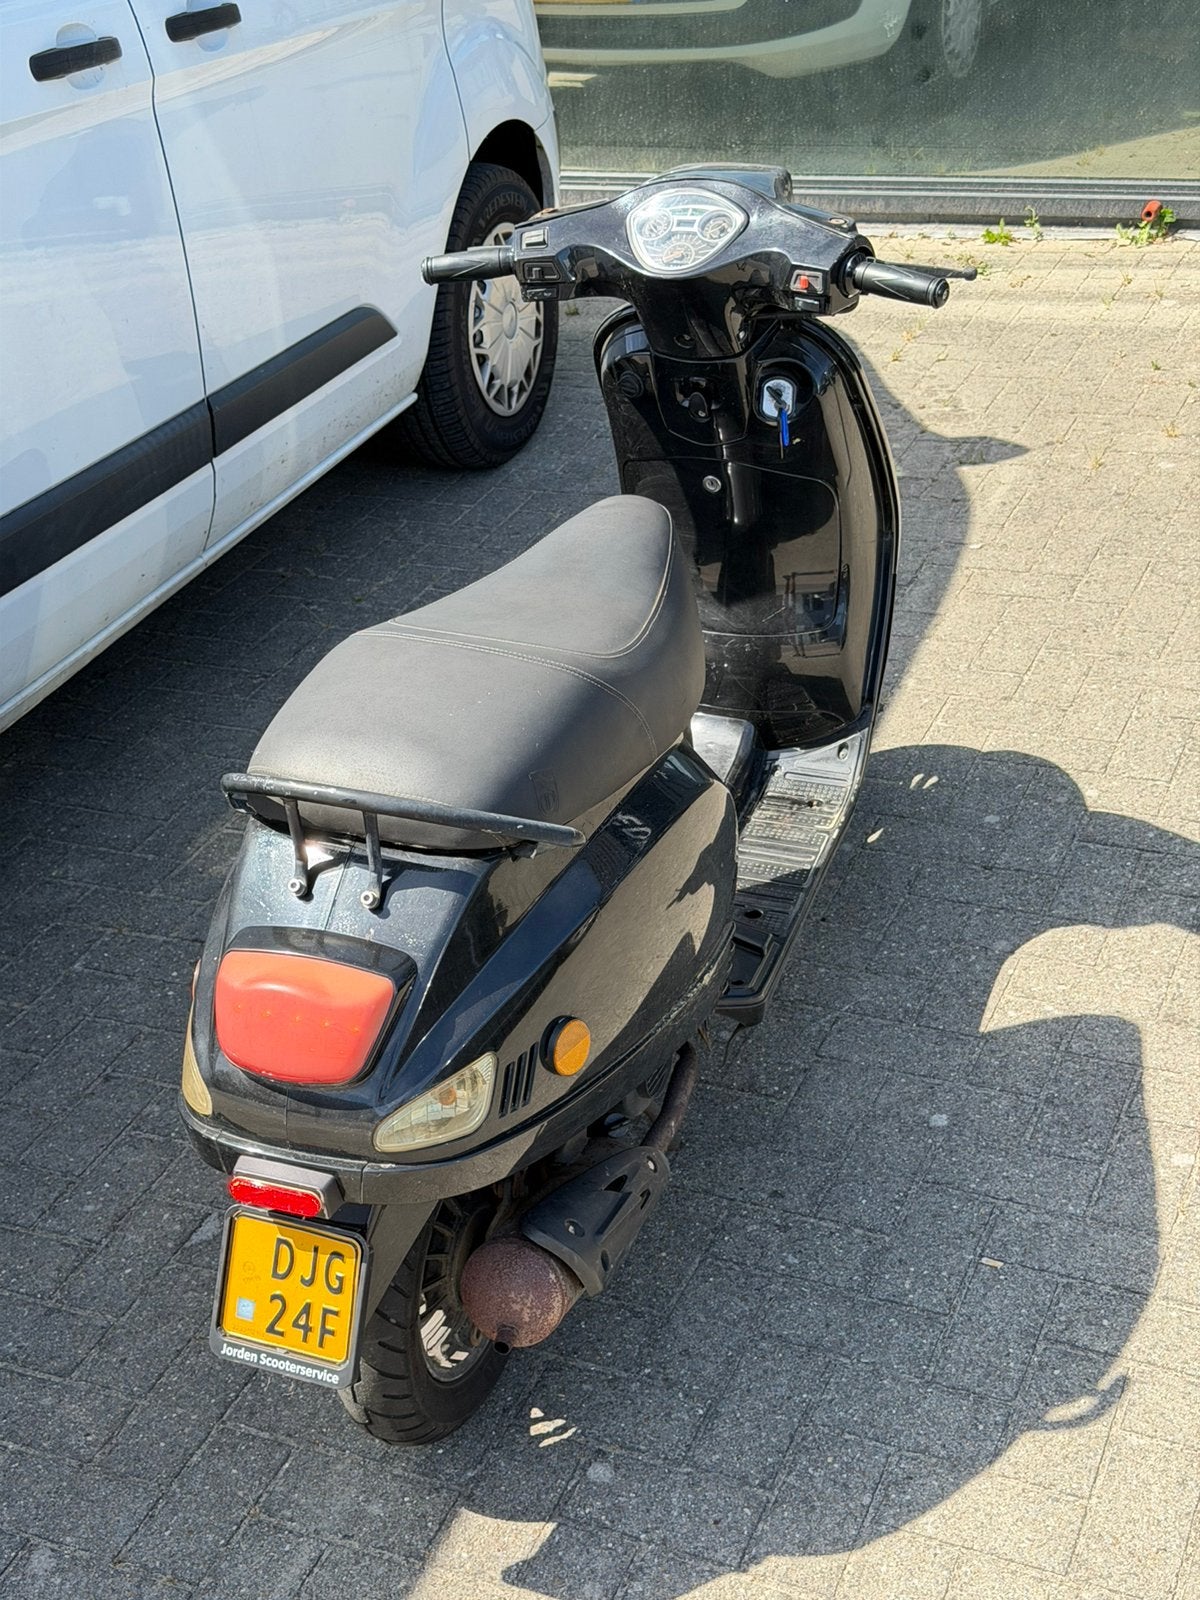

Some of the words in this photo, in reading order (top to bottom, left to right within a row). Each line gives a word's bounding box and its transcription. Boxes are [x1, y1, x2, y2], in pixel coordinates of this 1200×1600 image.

[271, 1237, 346, 1295] DJG
[265, 1293, 341, 1348] 24F
[221, 1343, 258, 1364] Jorden
[259, 1353, 340, 1385] Scooterservice
